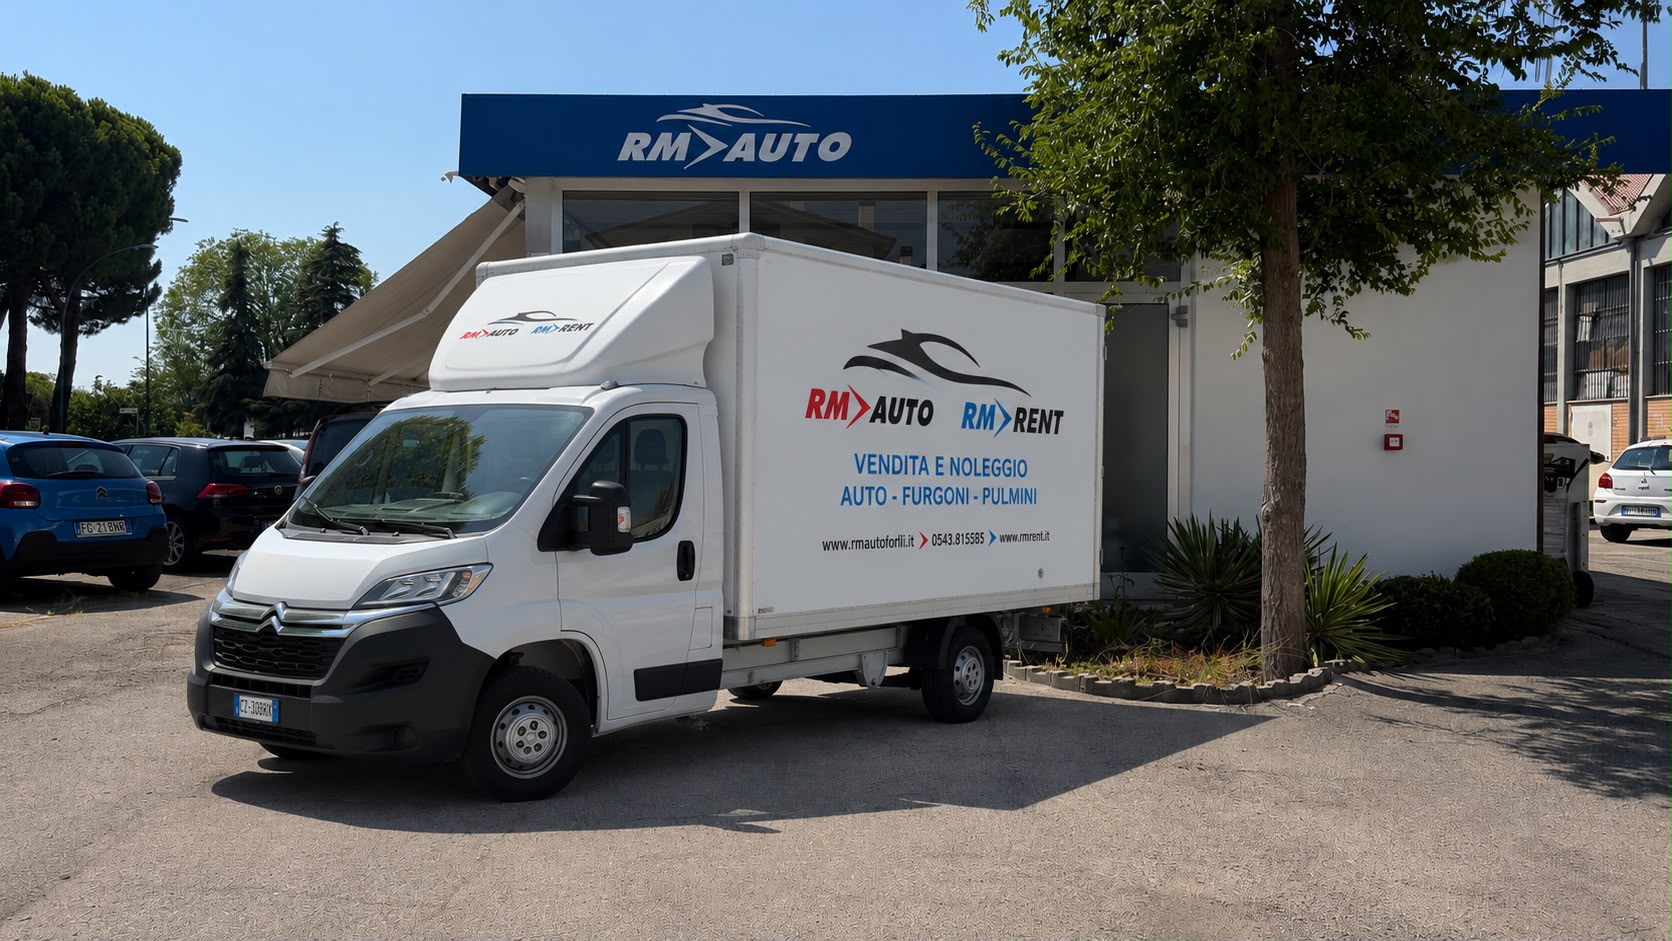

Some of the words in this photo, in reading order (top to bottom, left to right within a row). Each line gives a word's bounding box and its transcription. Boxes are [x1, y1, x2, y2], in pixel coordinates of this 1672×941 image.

[617, 132, 692, 161] RM
[722, 131, 852, 162] AUTO
[487, 328, 519, 337] AUTO
[558, 323, 594, 332] RENT
[805, 388, 850, 421] RM
[869, 396, 934, 427] AUTO
[961, 402, 996, 431] RM
[1013, 407, 1064, 435] RENT
[854, 453, 930, 476] VENDITA
[935, 456, 945, 476] E
[950, 457, 1028, 478] NOLEGGIO
[840, 486, 887, 506] AUTO
[902, 486, 969, 506] FURGONI
[982, 487, 1037, 505] PULMINI
[931, 531, 985, 547] 0543.815585
[999, 530, 1050, 544] www.rmrent.it
